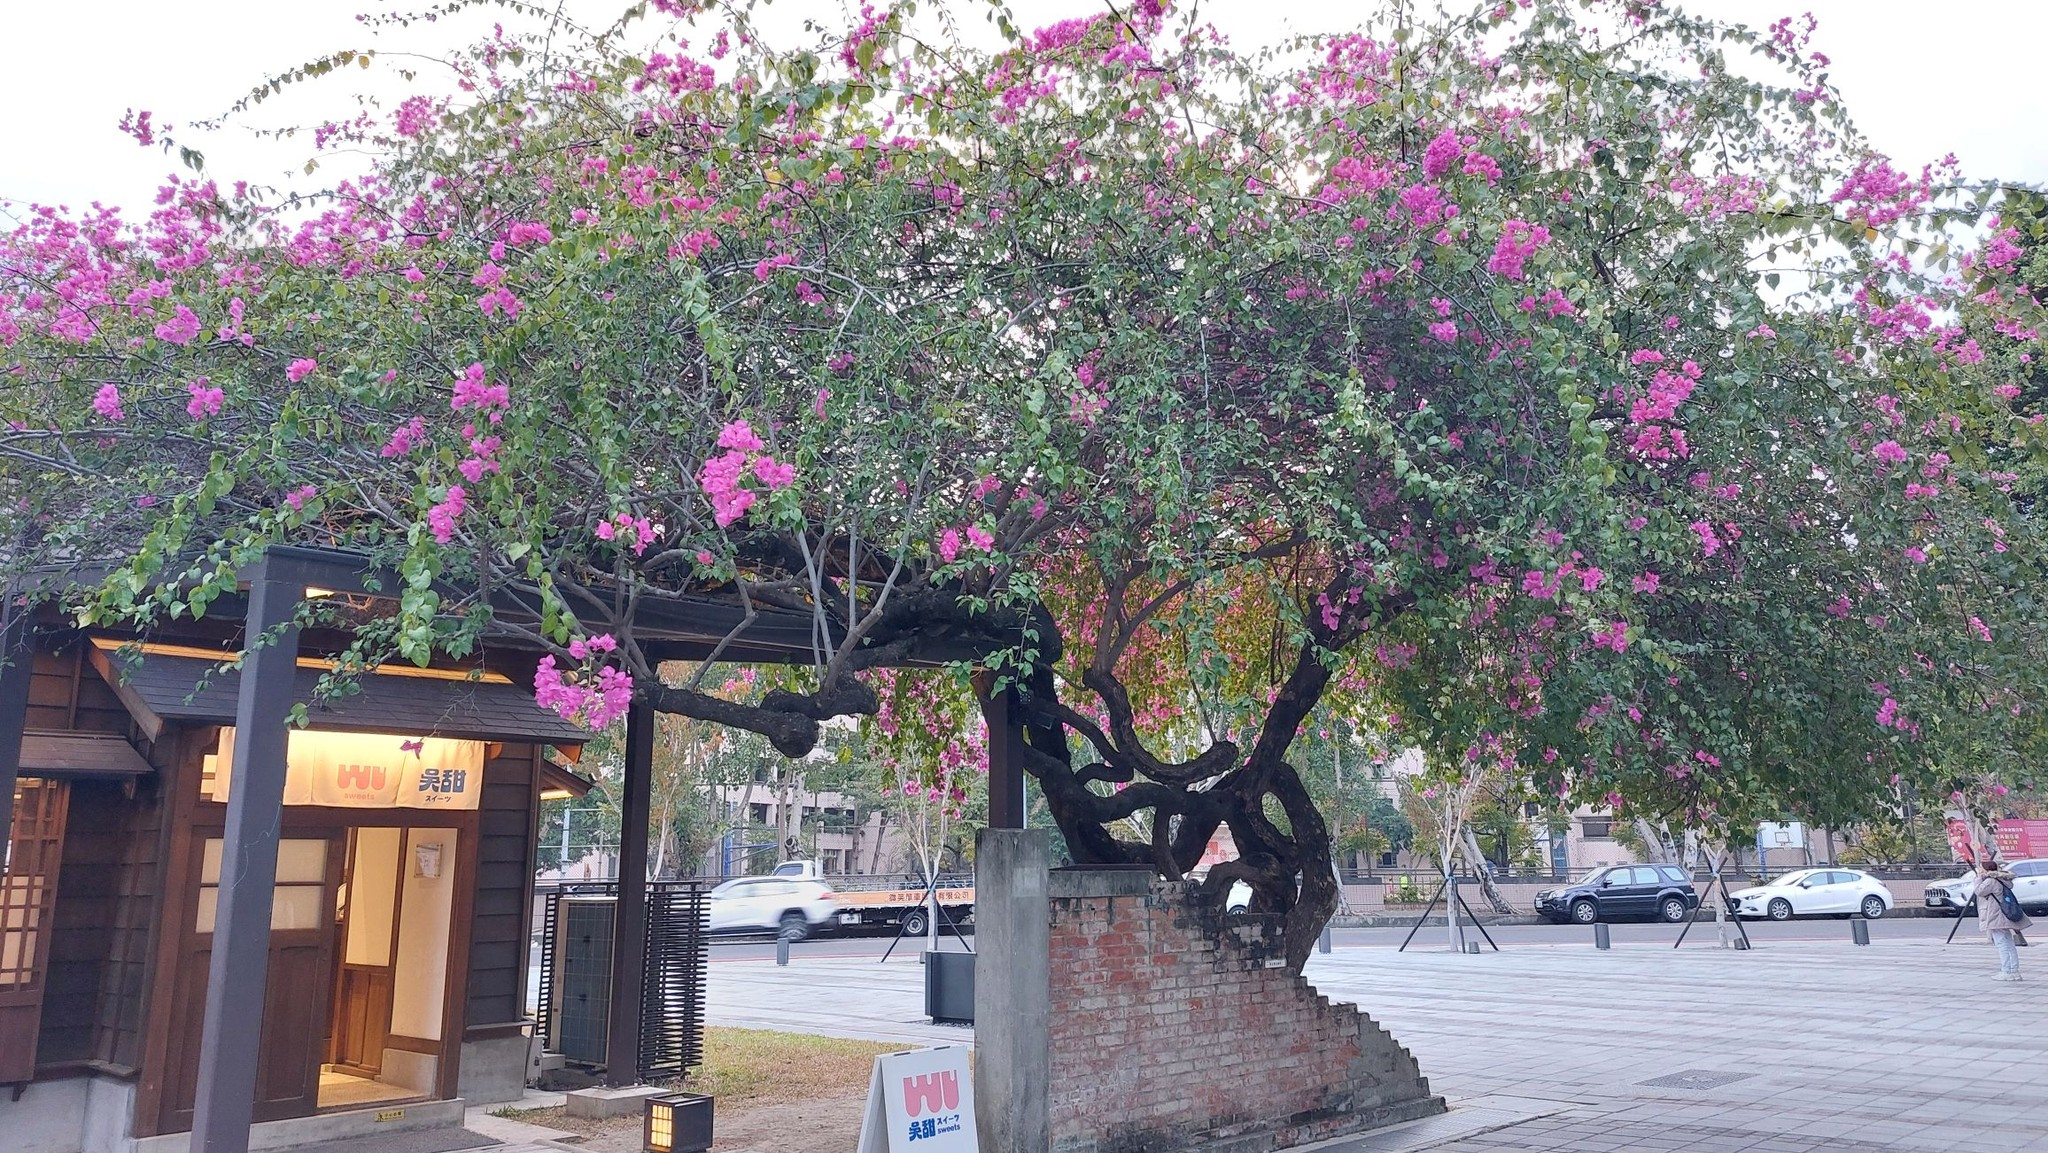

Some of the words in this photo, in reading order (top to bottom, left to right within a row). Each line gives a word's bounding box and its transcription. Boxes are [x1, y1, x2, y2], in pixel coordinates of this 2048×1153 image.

[419, 768, 466, 792] 吳甜
[344, 792, 375, 800] sweets
[937, 1114, 960, 1125] スイーツ
[909, 1118, 936, 1141] 吳甜
[937, 1123, 960, 1134] sweets
